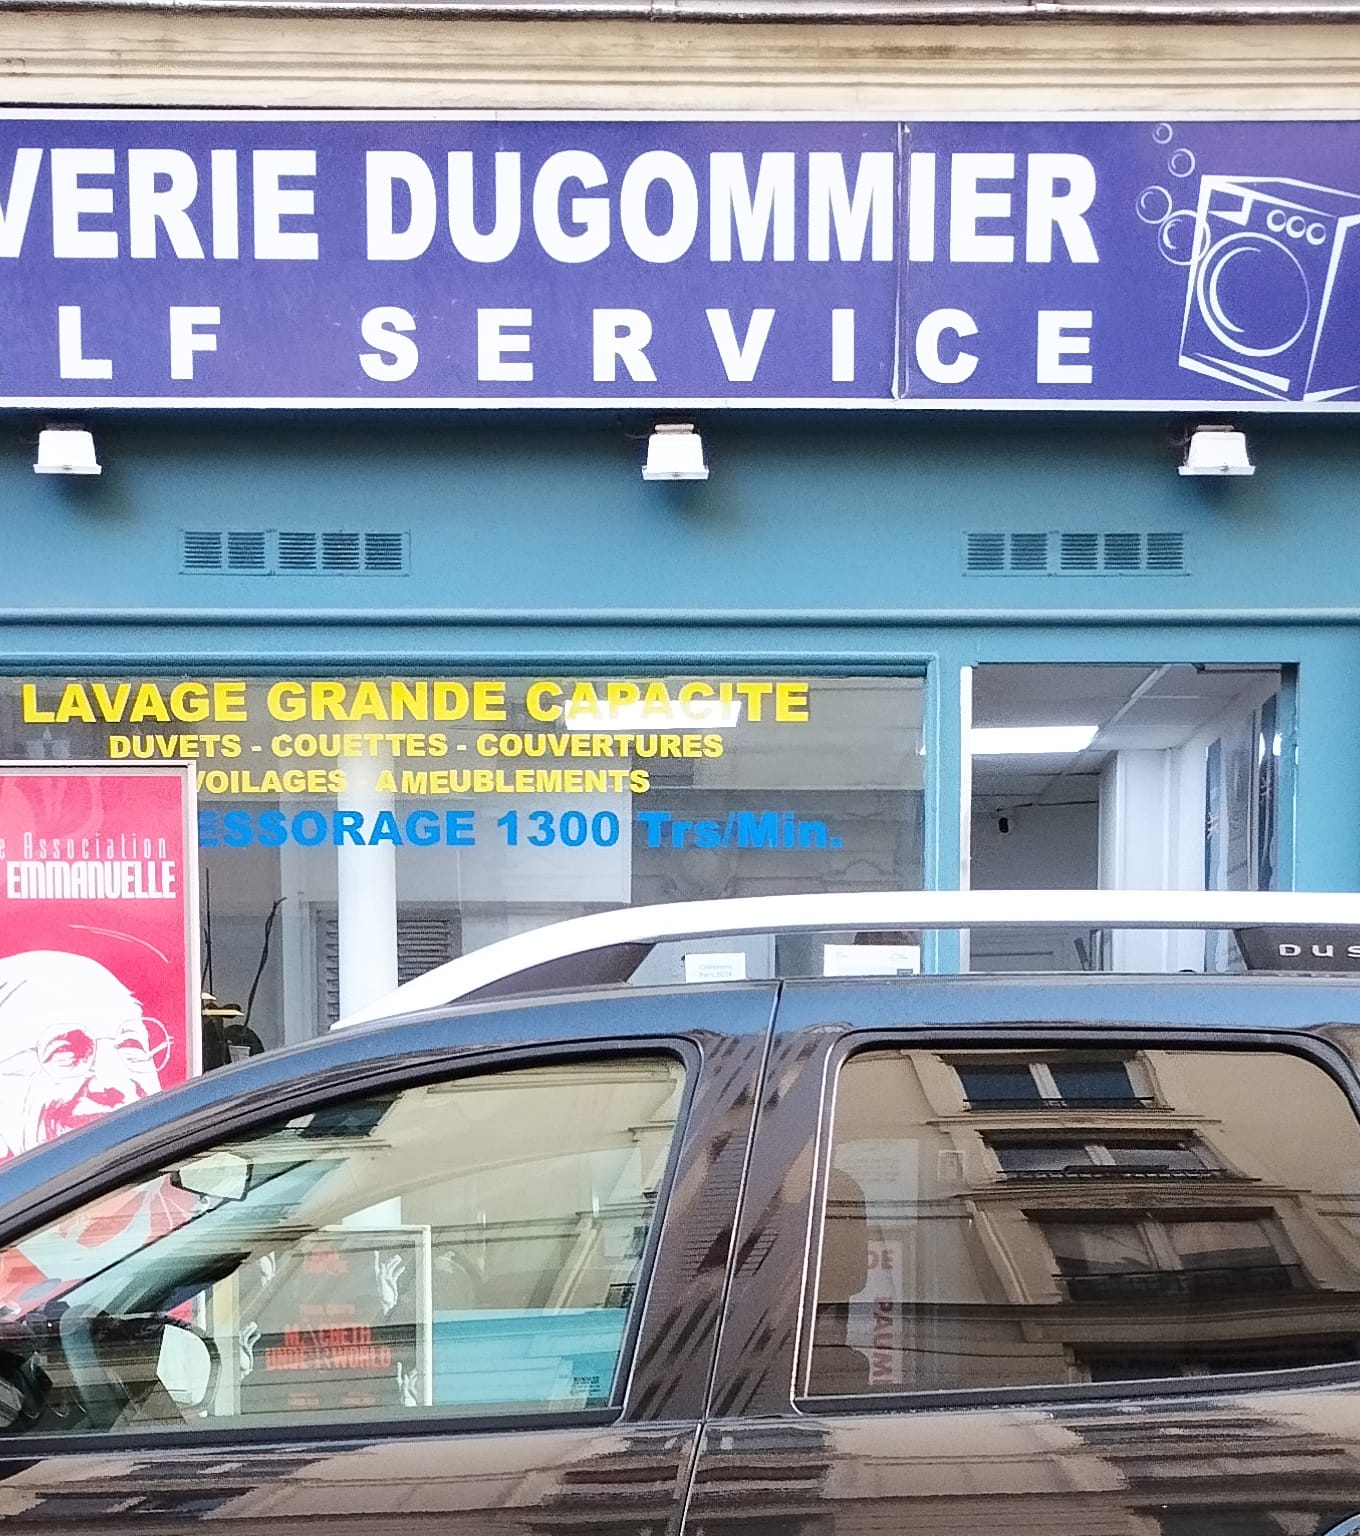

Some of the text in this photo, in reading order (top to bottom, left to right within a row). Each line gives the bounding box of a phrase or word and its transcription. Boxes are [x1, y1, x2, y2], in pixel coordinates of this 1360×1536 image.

[366, 151, 1100, 264] DUGOMMIER
[359, 307, 1093, 384] SERVICE
[23, 681, 809, 723] LAVAGE GRANDE CAPACITE
[109, 734, 241, 758] DUVETS
[271, 734, 447, 758] COUETTES
[477, 734, 723, 758] COUVERTURES
[376, 769, 650, 794] AMEUBLEMENTS
[24, 832, 167, 860] Association
[199, 810, 844, 849] ESSORAGE 1300 Trs/Min.
[7, 861, 177, 899] EMMANUELLE
